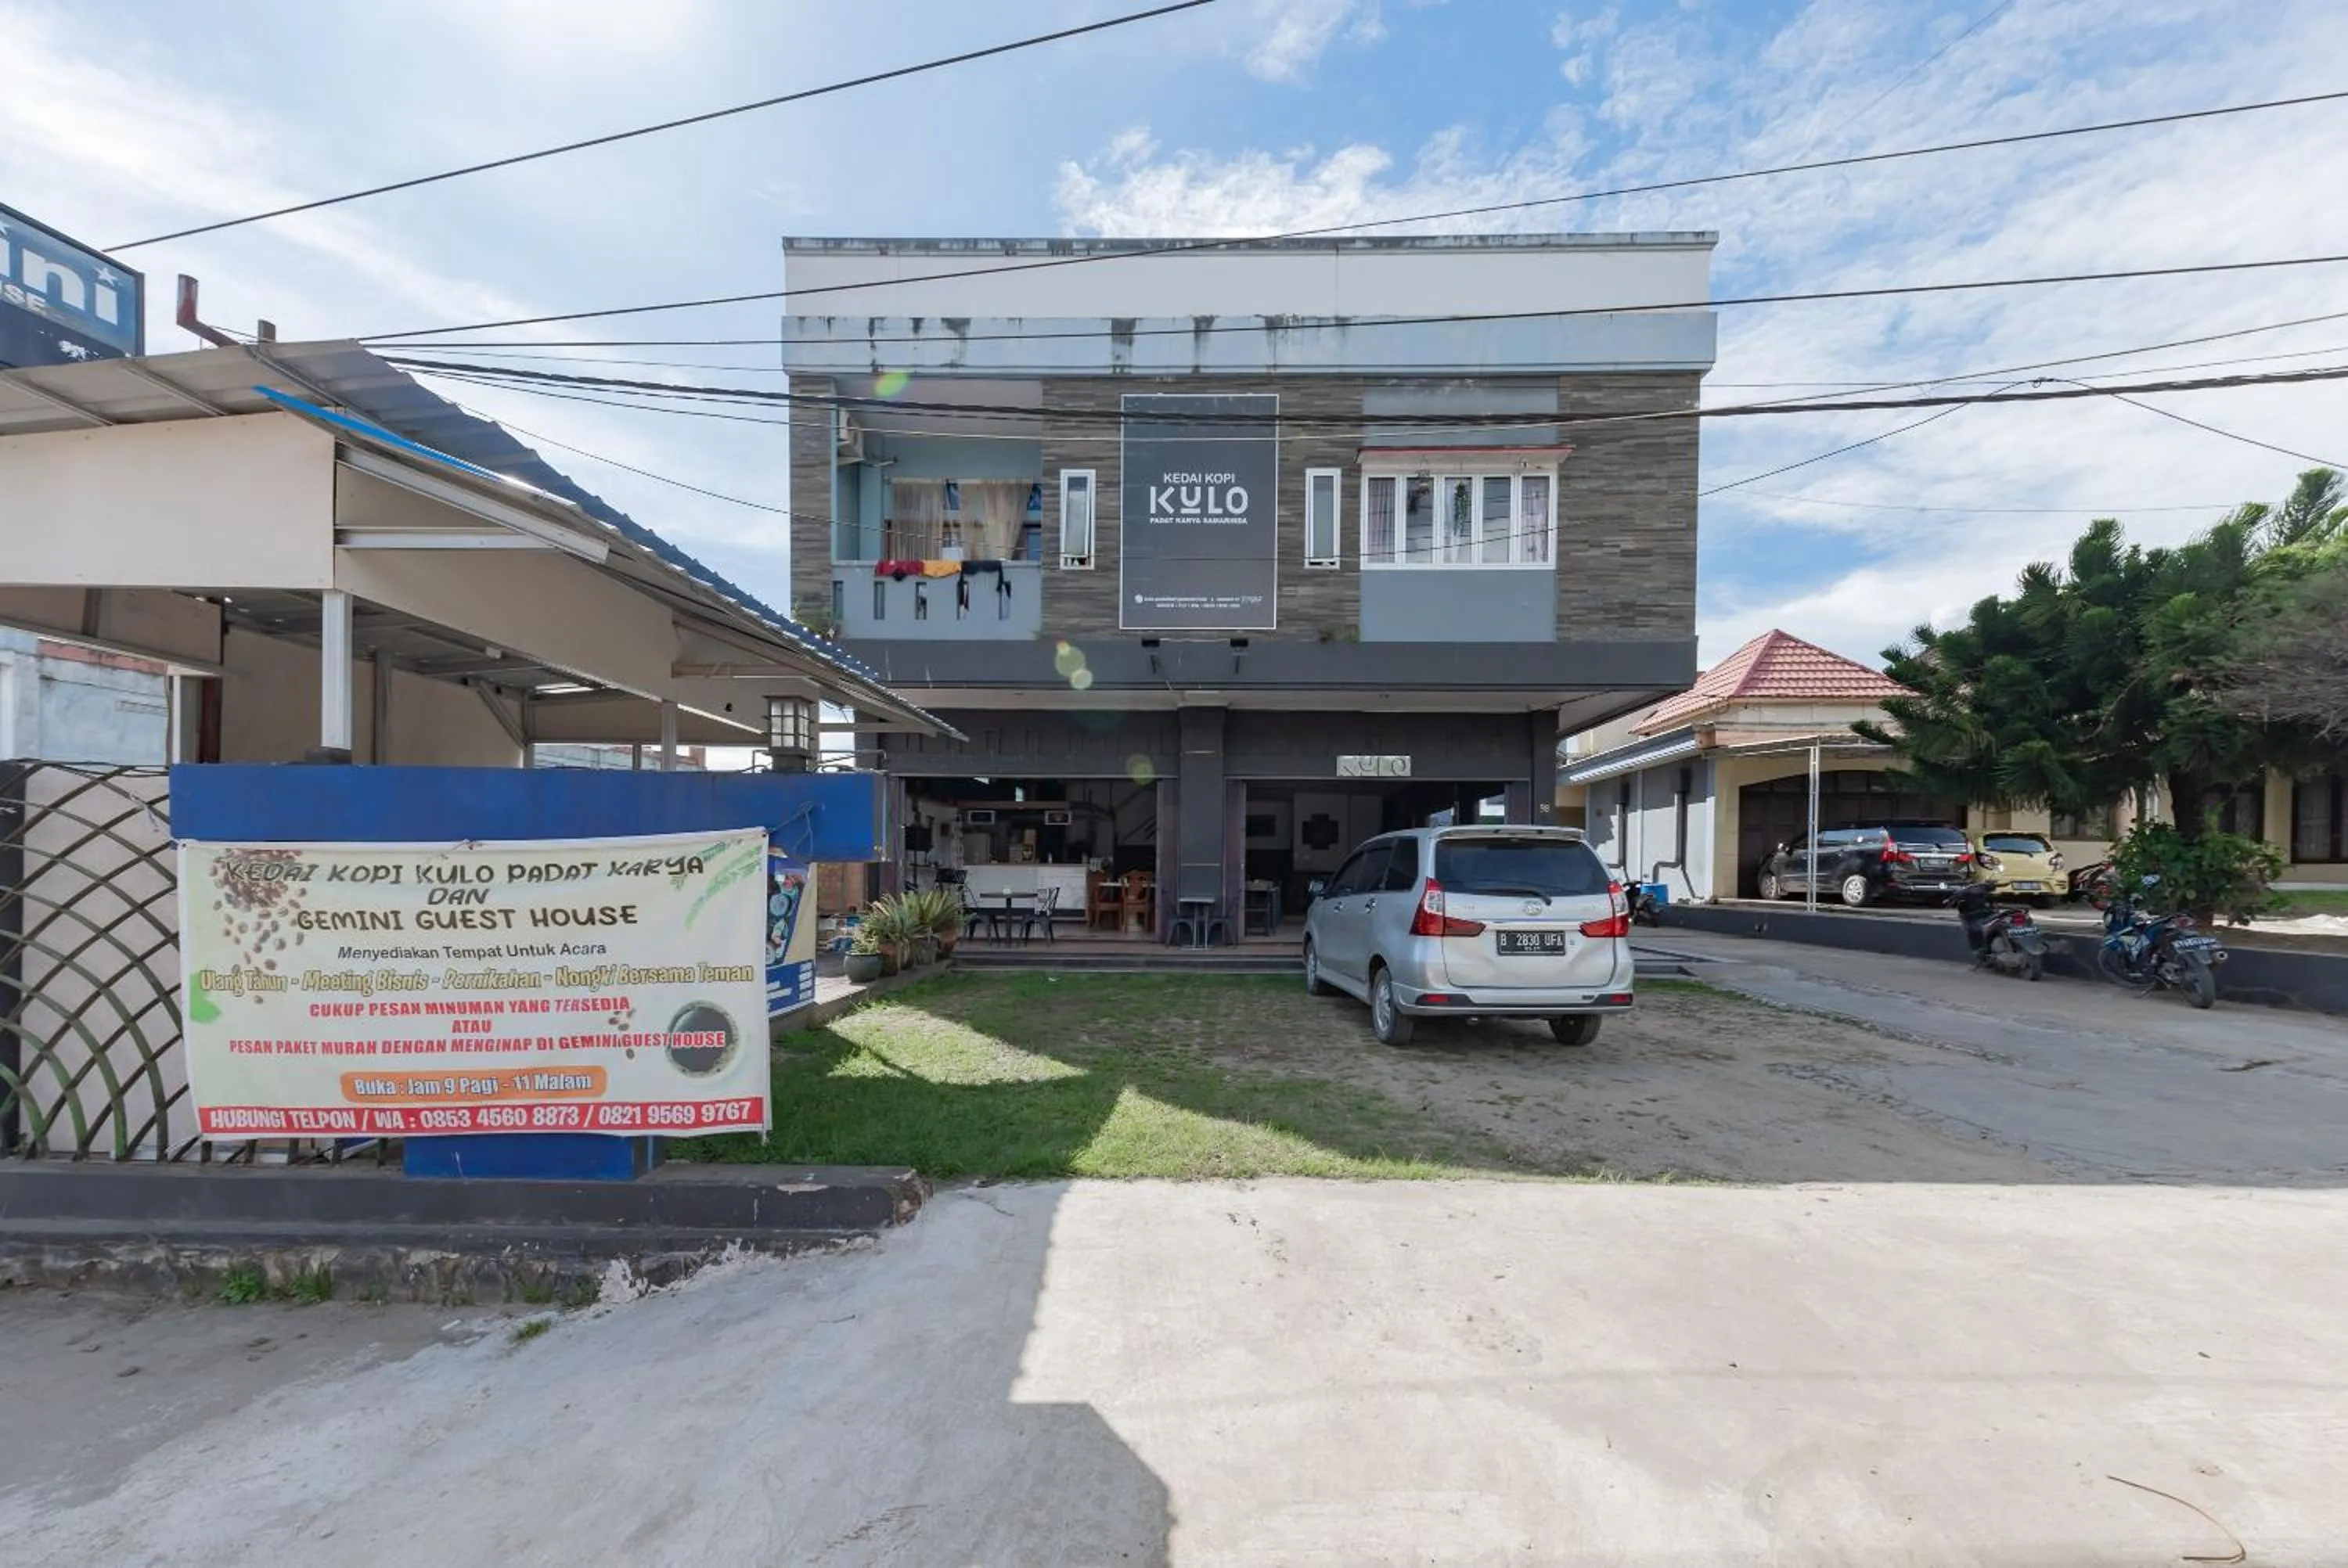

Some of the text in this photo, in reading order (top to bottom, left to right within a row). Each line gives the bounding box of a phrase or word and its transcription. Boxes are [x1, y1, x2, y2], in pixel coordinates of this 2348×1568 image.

[0, 282, 47, 316] SE
[1164, 473, 1235, 483] KEDAI KOPI
[1150, 486, 1248, 514] KULO
[227, 855, 704, 885] KEDAI KOPI KULO PADAT KARYA
[427, 886, 492, 905] DAN
[297, 905, 638, 931] GEMINI GUEST HOUSE
[1500, 933, 1507, 946] B
[1516, 933, 1540, 946] 2830
[337, 942, 607, 962] Menyediakan Tempat Untuk Acara
[200, 969, 245, 998] Ulang
[301, 969, 374, 998] Meeting
[376, 969, 429, 991] Bisnis
[441, 967, 542, 990] Pernikahan
[617, 963, 695, 985] Bersama
[695, 961, 755, 983] Teman
[309, 997, 630, 1017] CUKUP PESAN MINUMAN YANG TERSEDIA
[452, 1020, 492, 1034] ATAU
[229, 1031, 726, 1055] PESAN PAKET MURAH DENGAN MENGINAP DI GEMINI GUEST HOUSE
[355, 1078, 398, 1095] Buka
[406, 1077, 441, 1095] Jam
[444, 1077, 456, 1095] 9
[459, 1075, 499, 1095] Pagi
[512, 1074, 531, 1091] 11
[534, 1073, 593, 1091] Malam
[210, 1109, 286, 1129] HUBUNGI
[289, 1109, 356, 1129] TELPON
[374, 1109, 405, 1129] WA
[420, 1109, 472, 1128] 0853
[476, 1107, 528, 1127] 4560
[532, 1106, 580, 1127] 8873
[598, 1105, 642, 1125] 0821
[646, 1104, 697, 1125] 9569
[700, 1101, 752, 1123] 9767
